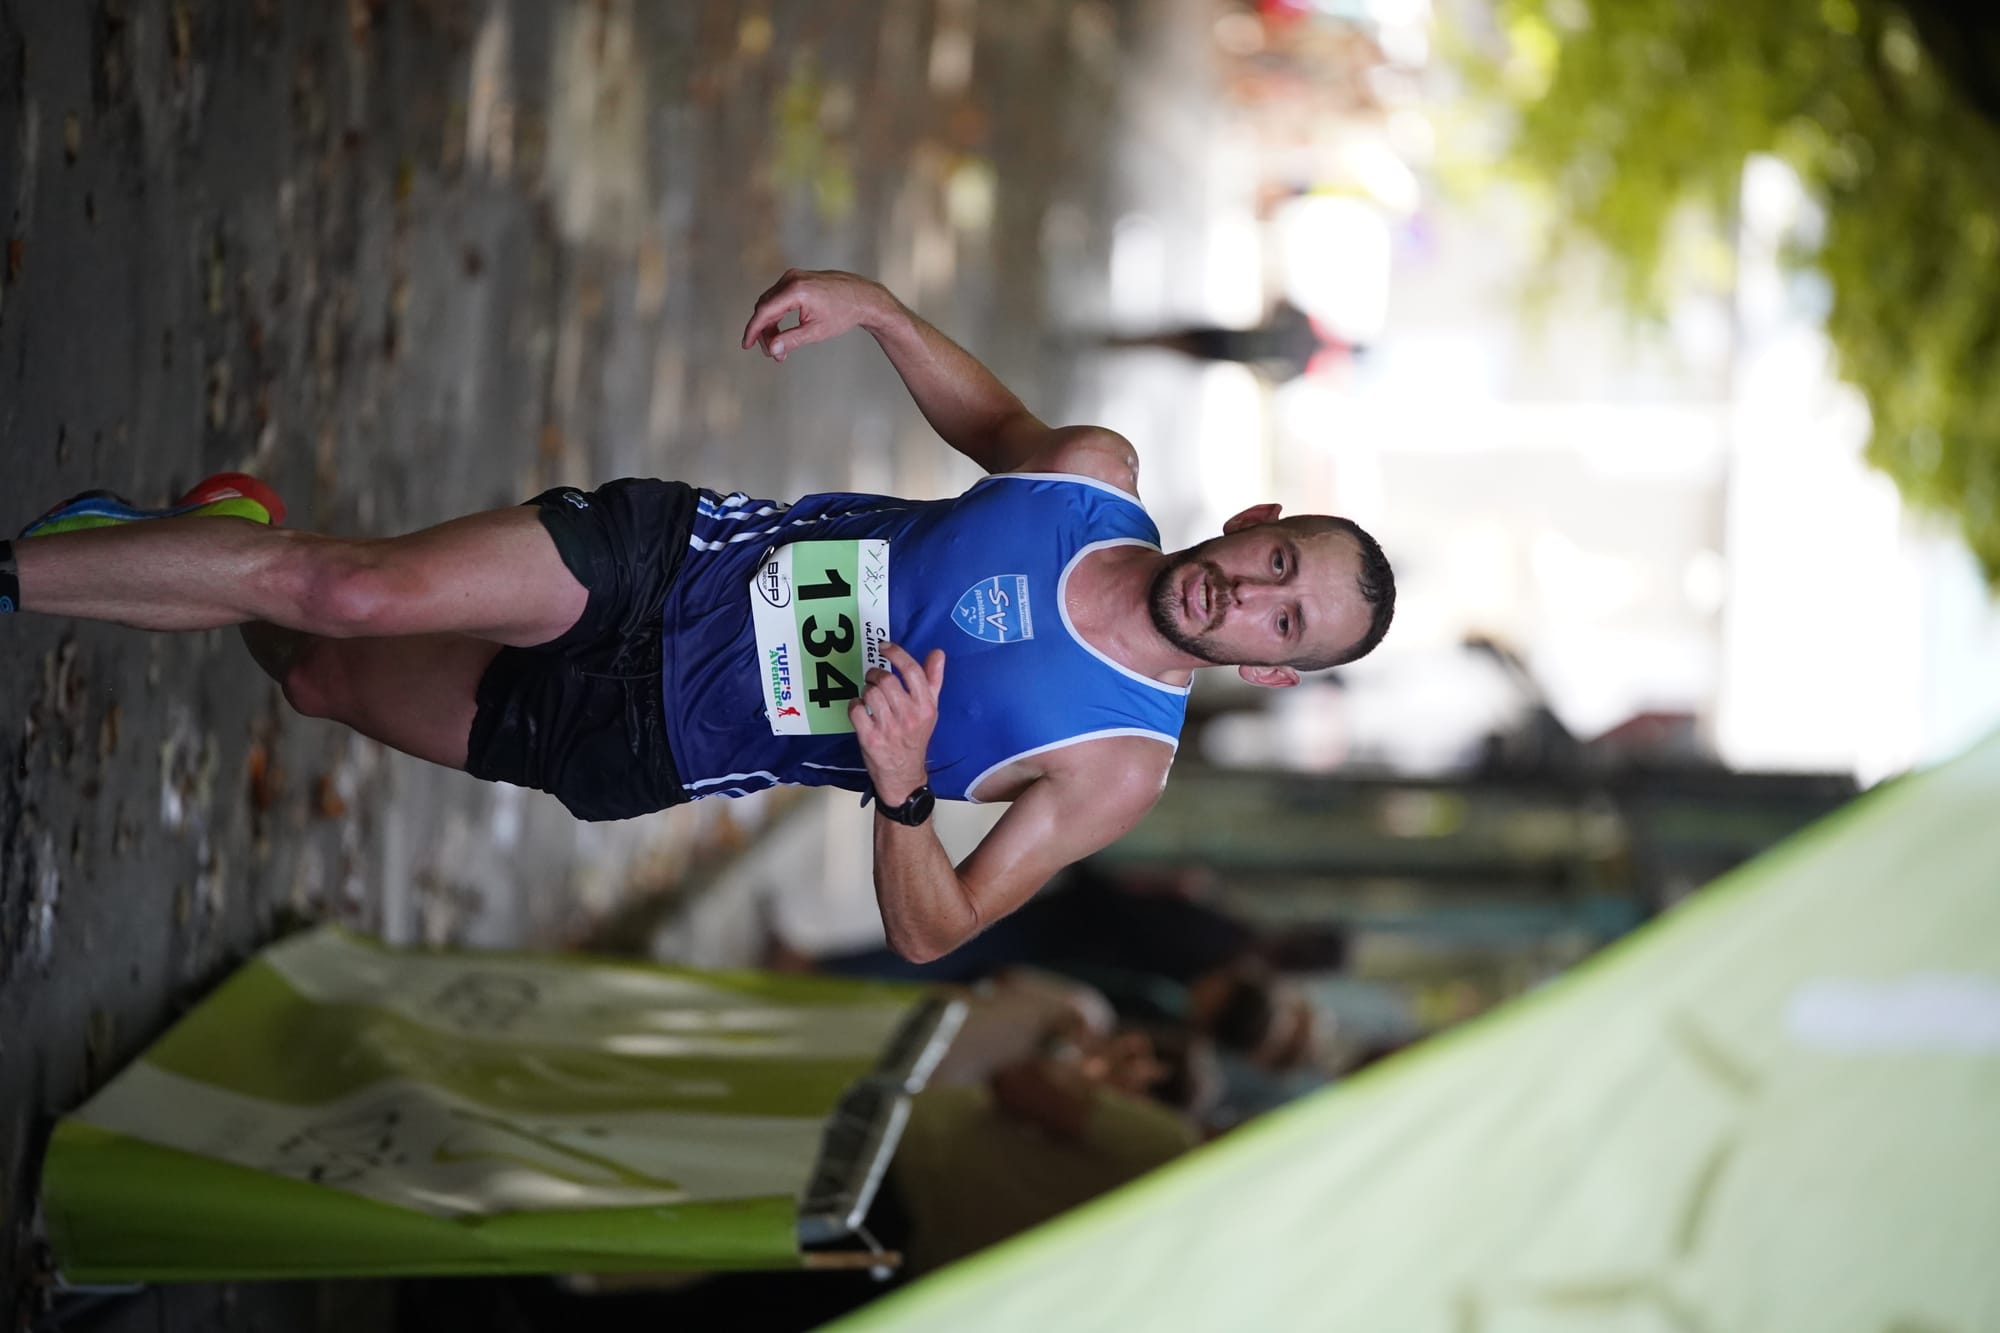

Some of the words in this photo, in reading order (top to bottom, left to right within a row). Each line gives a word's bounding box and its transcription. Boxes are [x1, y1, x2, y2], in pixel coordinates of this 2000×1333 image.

[768, 561, 779, 601] BFP
[985, 588, 1009, 631] SV
[797, 568, 858, 708] 134
[876, 627, 887, 670] Chlle
[769, 649, 783, 707] Aventure
[776, 643, 792, 701] TUFF'S
